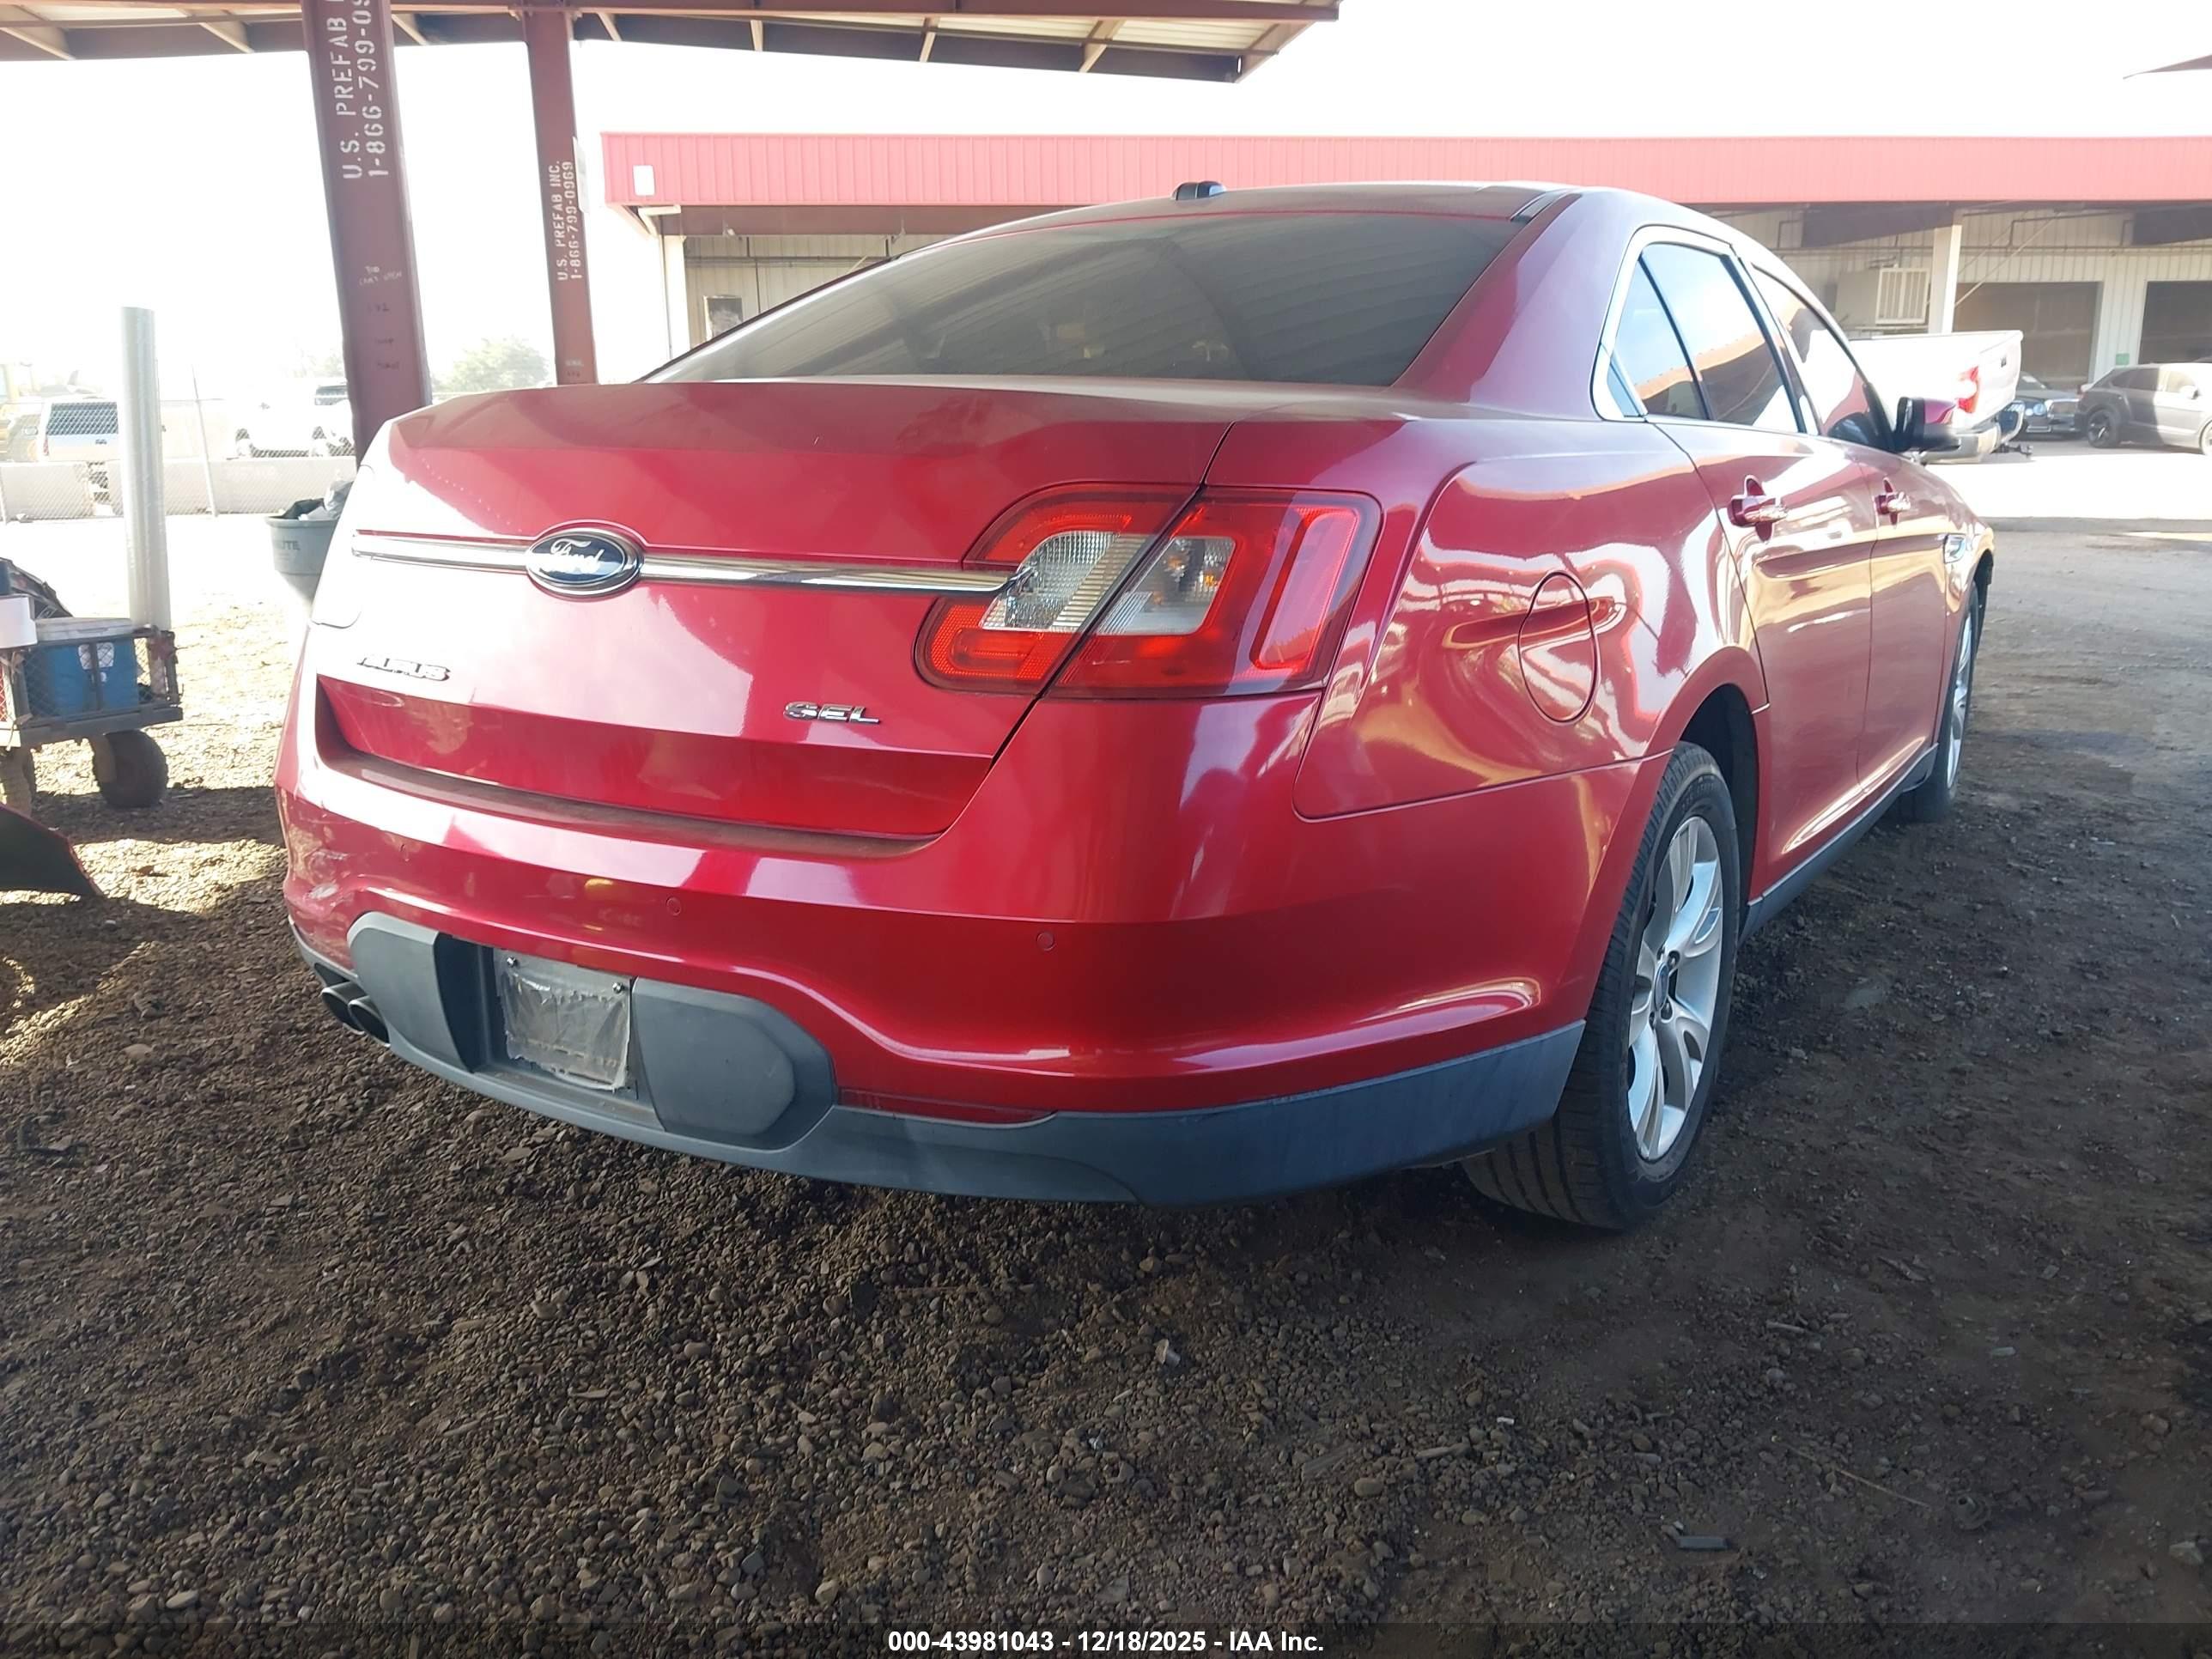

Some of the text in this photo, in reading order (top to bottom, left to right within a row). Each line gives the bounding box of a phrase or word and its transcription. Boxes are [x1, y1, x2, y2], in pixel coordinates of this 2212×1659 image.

[326, 16, 356, 117] PREFAB
[340, 131, 363, 179] U.S.
[548, 161, 562, 187] INC.
[550, 193, 567, 247] PREFAB
[562, 161, 583, 279] 1-866-799-0969
[547, 537, 605, 574] Ford
[783, 701, 881, 724] SEL
